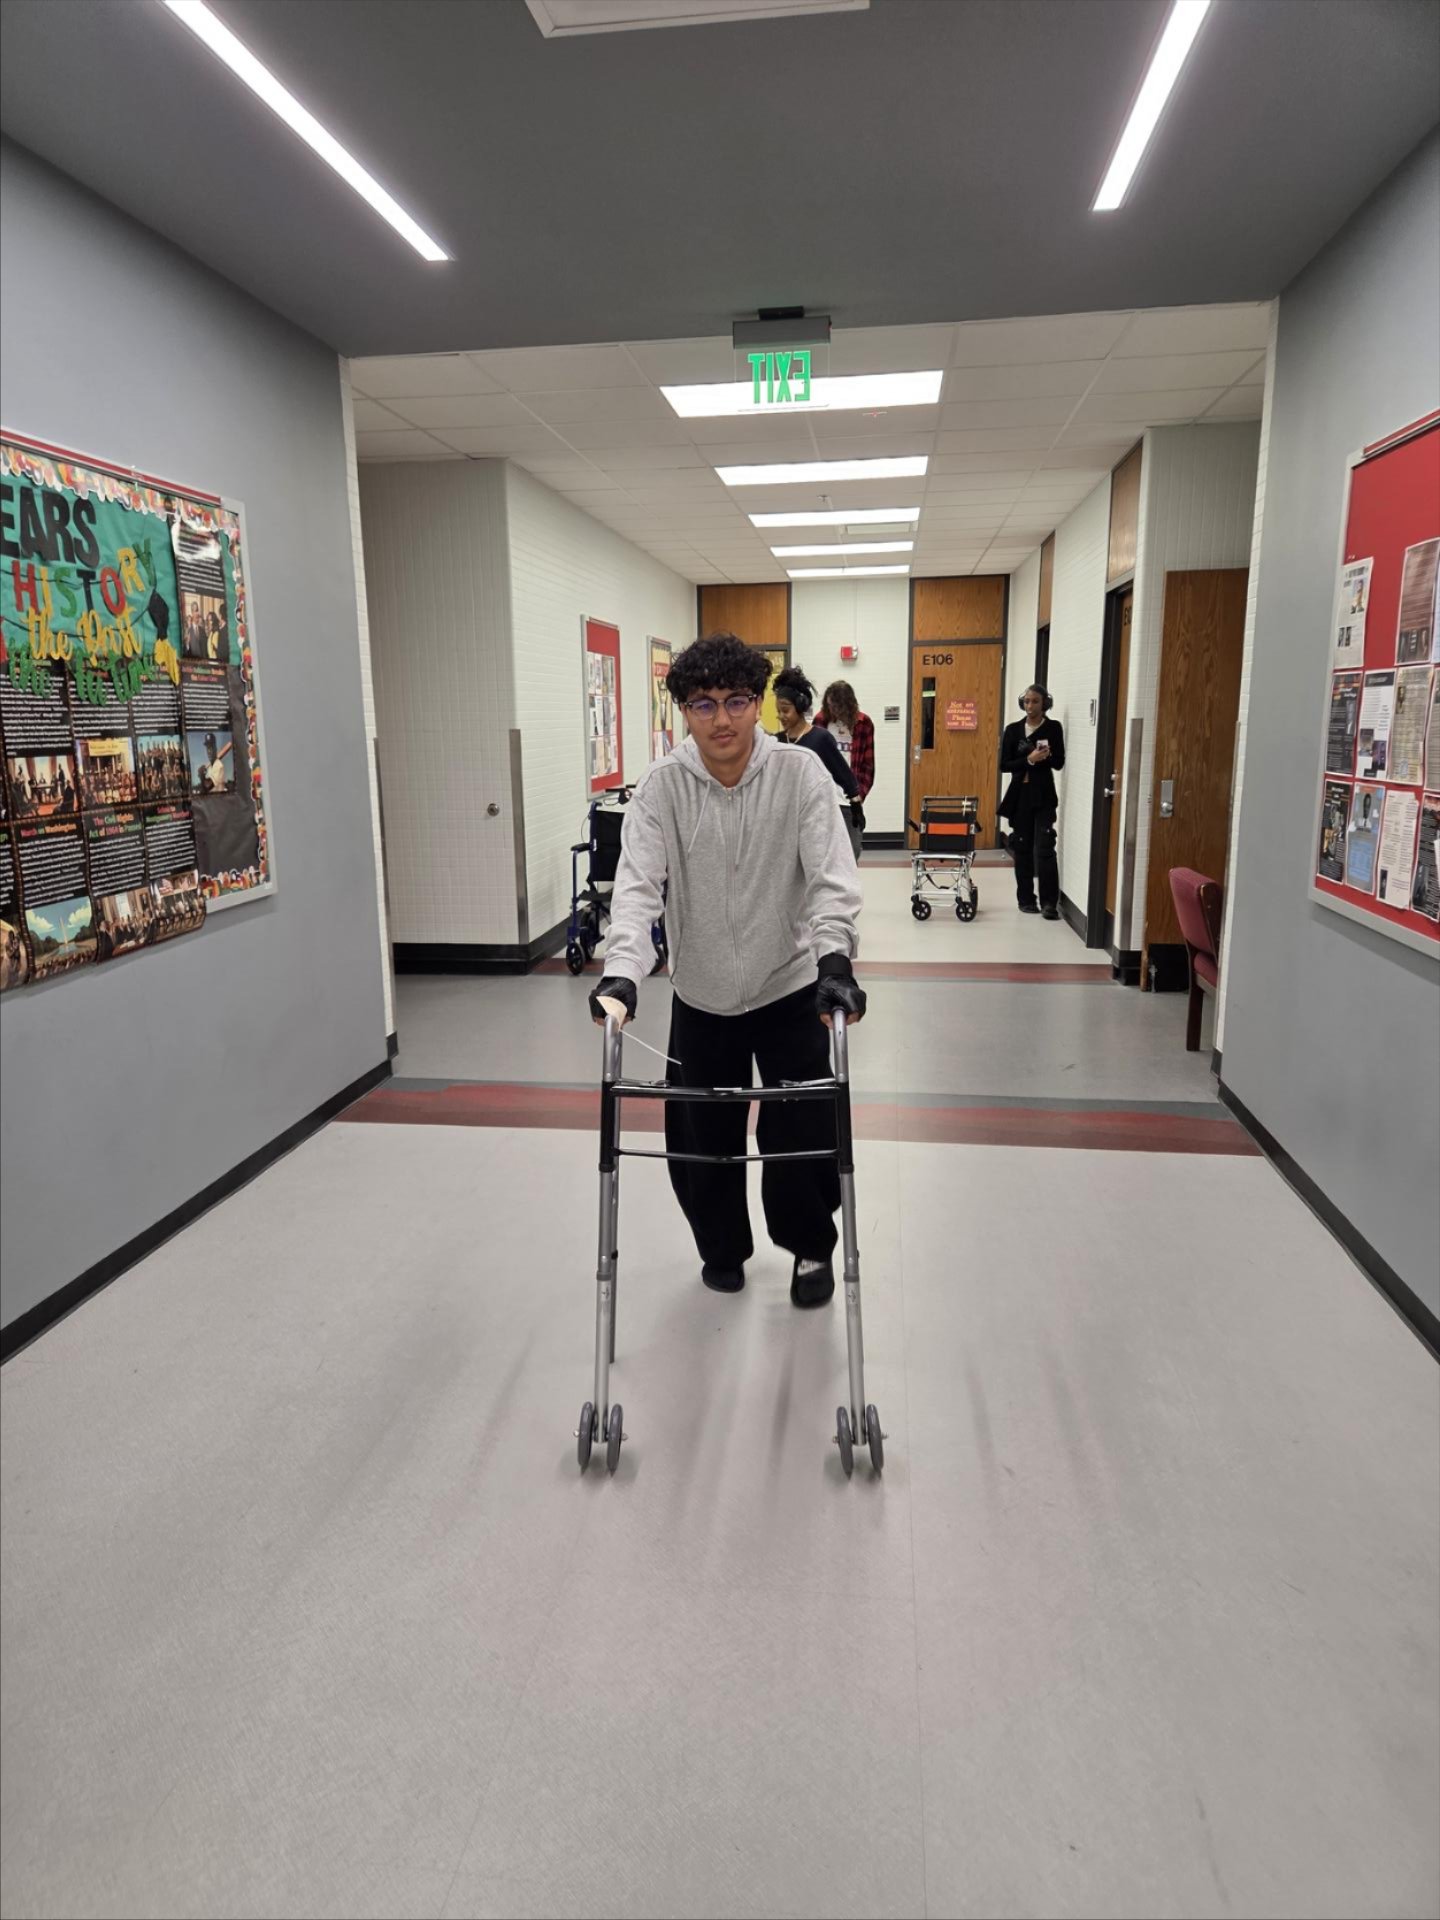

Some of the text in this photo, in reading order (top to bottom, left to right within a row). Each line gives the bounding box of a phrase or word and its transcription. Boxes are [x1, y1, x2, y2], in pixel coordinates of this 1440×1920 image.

[12, 539, 155, 618] HISTORY
[20, 602, 142, 667] the Past
[923, 653, 954, 666] E106
